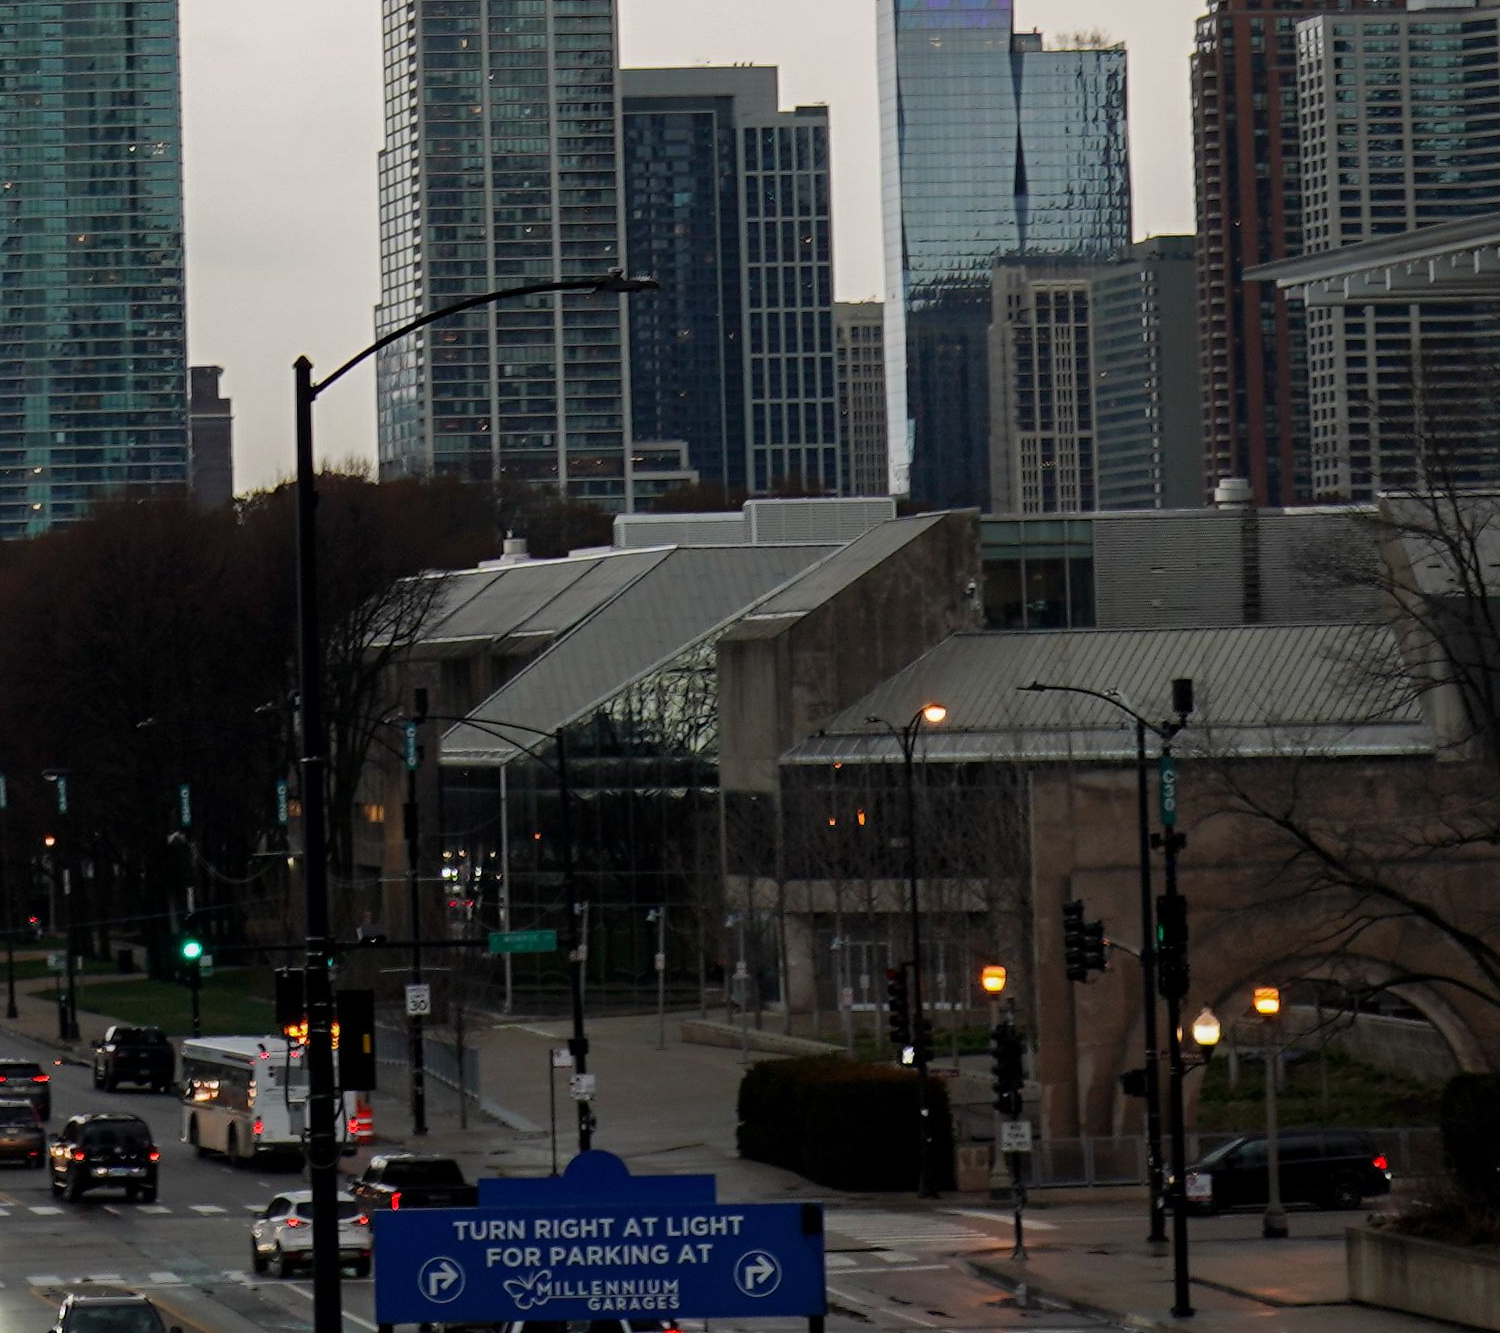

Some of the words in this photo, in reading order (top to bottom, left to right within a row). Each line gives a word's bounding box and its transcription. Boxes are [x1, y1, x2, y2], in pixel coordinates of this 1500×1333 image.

[453, 1220, 526, 1241] TURN
[534, 1217, 615, 1240] RIGHT
[623, 1217, 659, 1238] AT
[666, 1215, 744, 1237] LIGHT
[486, 1247, 542, 1268] FOR
[550, 1244, 670, 1267] PARKING
[677, 1244, 714, 1264] AT
[535, 1279, 680, 1296] MILLENNIUM
[587, 1296, 681, 1311] GARAGES
